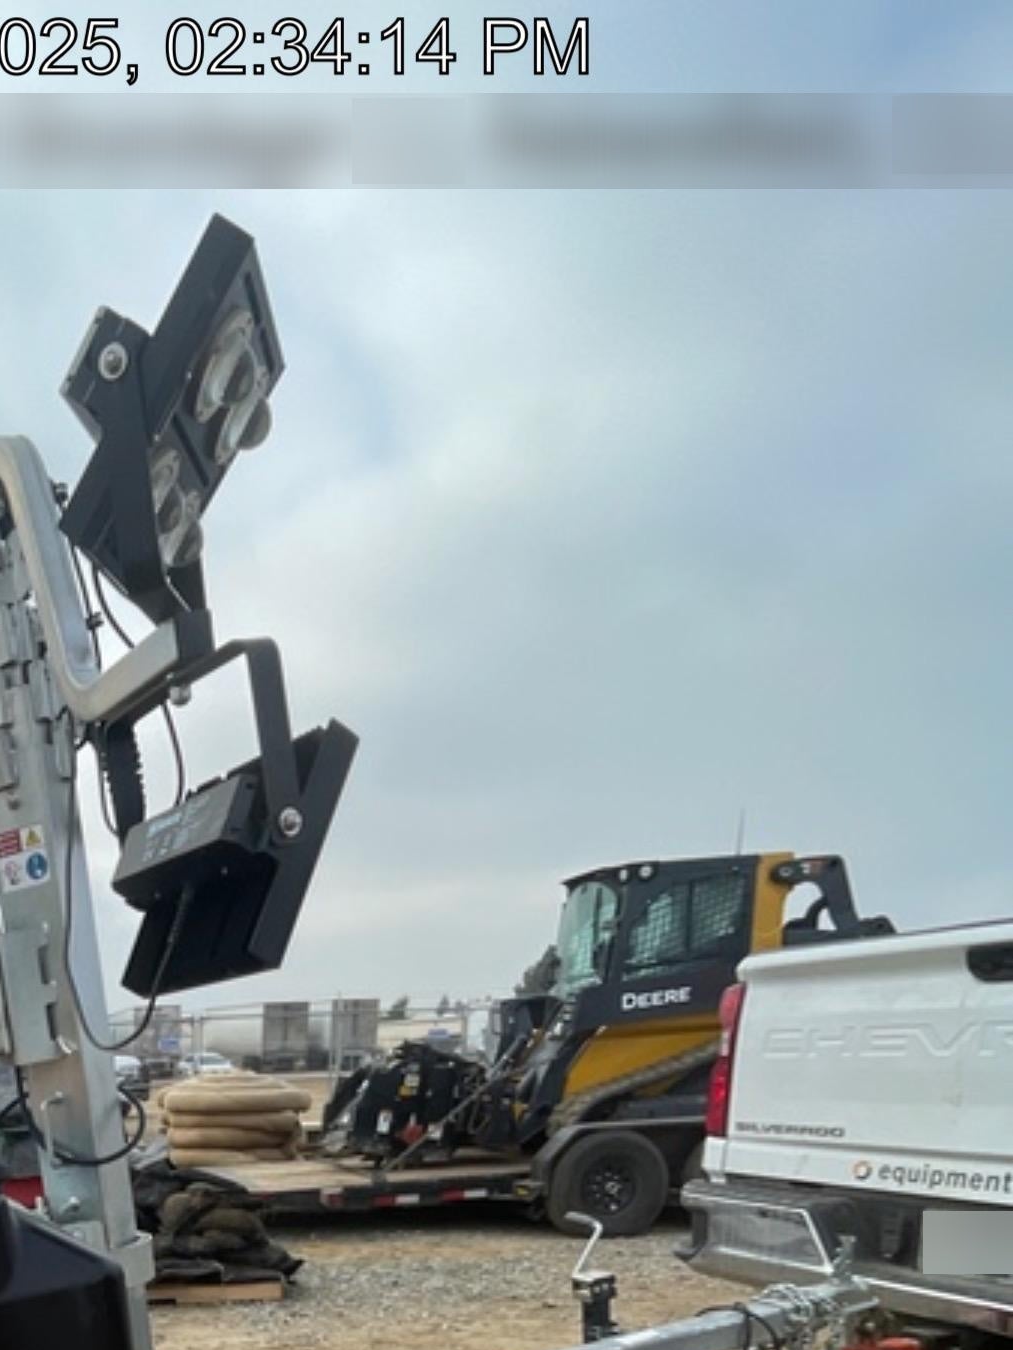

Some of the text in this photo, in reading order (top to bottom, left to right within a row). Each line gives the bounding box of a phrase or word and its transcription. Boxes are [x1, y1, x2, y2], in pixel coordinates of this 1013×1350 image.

[622, 986, 691, 1010] DEERE
[735, 1121, 845, 1137] SILVERADO
[878, 1162, 1013, 1192] equipment
